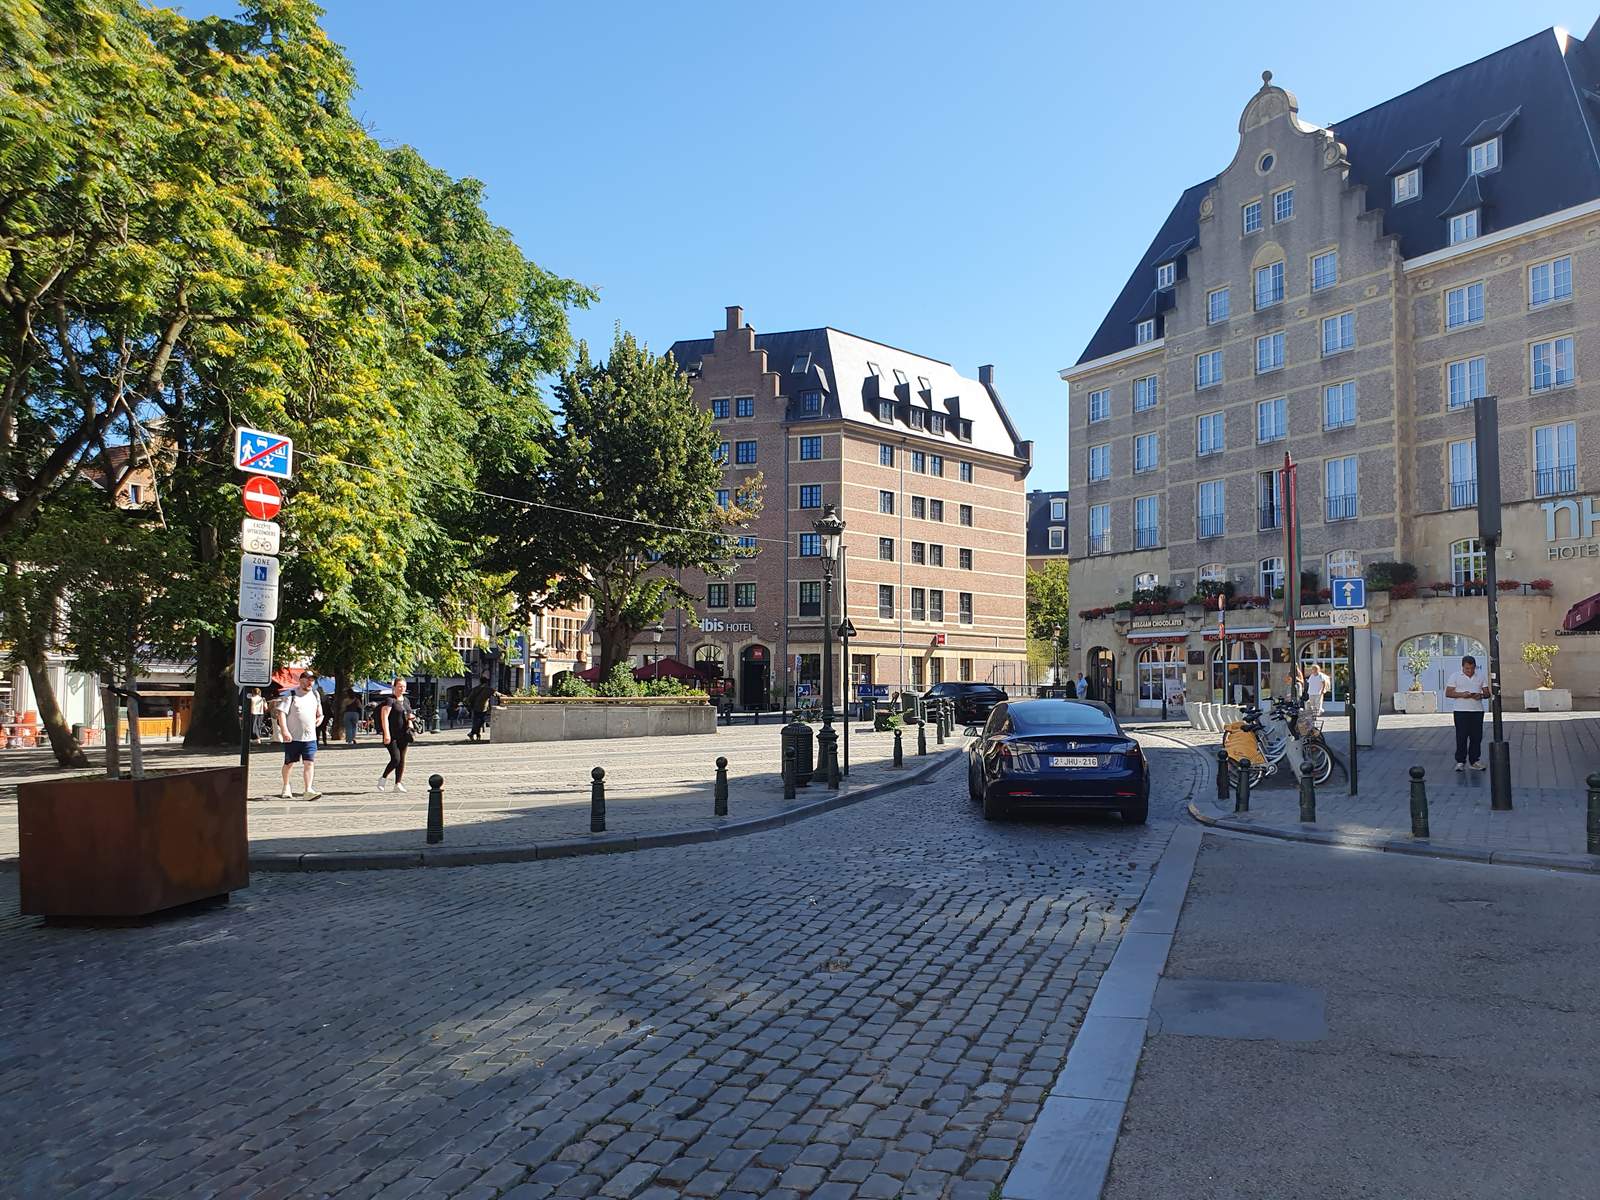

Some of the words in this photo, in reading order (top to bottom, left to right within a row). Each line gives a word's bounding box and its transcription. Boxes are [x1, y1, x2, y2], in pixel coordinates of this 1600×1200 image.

[1547, 543, 1600, 560] HOTE
[252, 557, 271, 566] ZONE
[726, 623, 754, 632] HOTEL
[1152, 619, 1183, 627] CHOCOLATES
